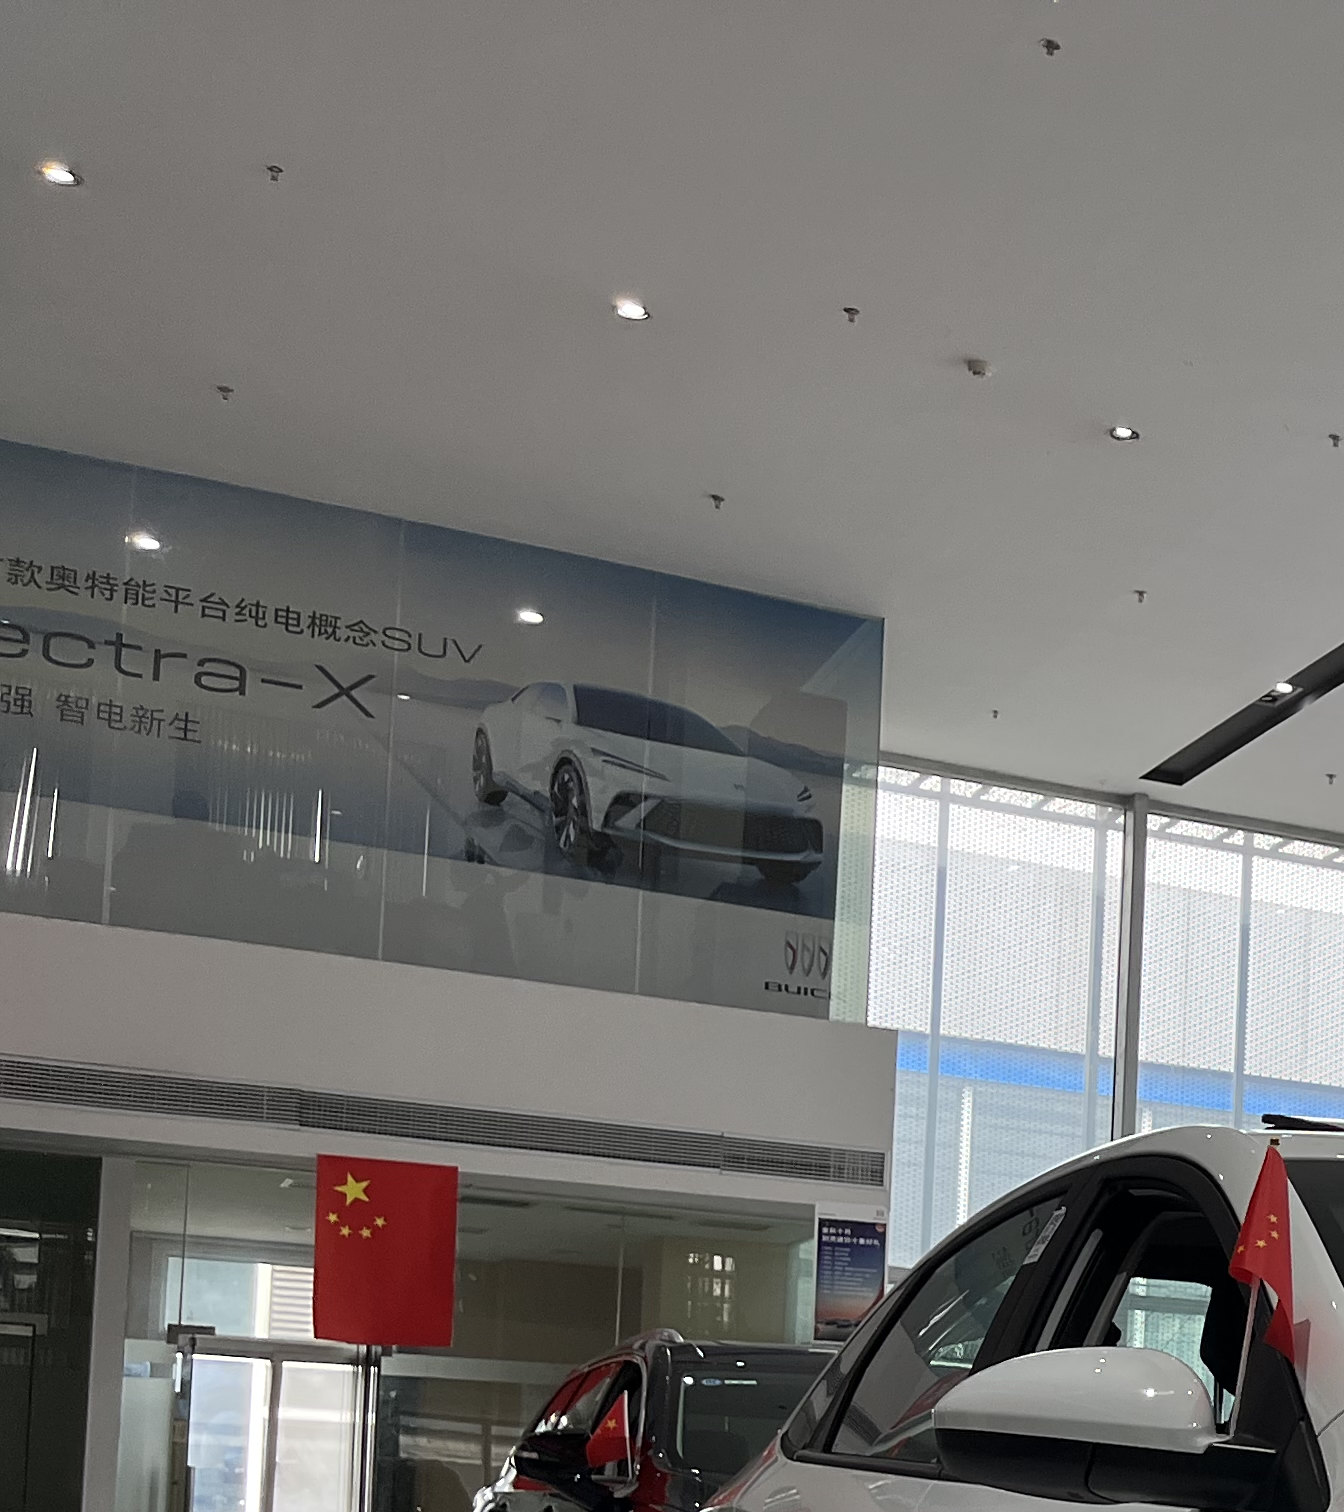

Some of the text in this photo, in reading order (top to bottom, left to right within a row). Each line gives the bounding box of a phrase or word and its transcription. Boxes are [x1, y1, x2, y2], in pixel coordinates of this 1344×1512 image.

[0, 556, 483, 664] 款奥特能平台纯电概念SUV
[56, 692, 202, 744] 智电新生
[764, 981, 831, 1000] BUIC
